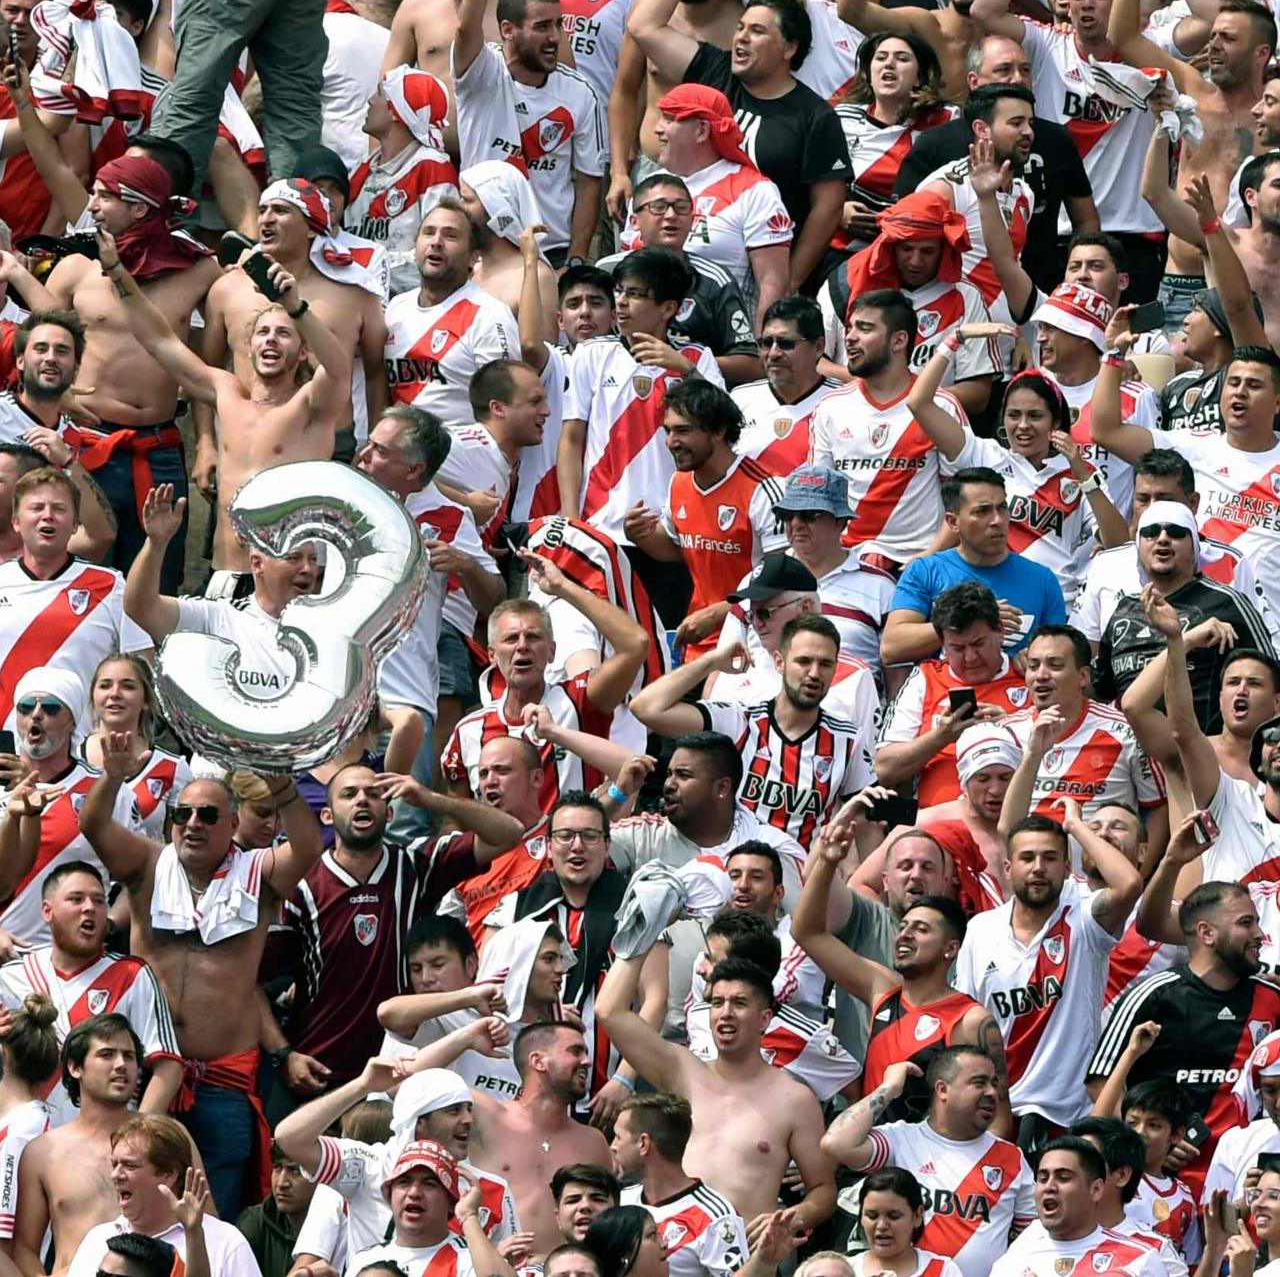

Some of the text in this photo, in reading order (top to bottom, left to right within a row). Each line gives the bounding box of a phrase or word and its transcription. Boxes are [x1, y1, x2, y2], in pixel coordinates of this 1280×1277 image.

[834, 455, 926, 471] PETROBRAS
[1008, 499, 1063, 536] BVA
[694, 536, 741, 552] Francés
[239, 670, 279, 689] BBVA
[741, 775, 822, 817] BBVA
[349, 893, 377, 903] adidas
[991, 975, 1062, 1019] BBVA
[1176, 1068, 1239, 1084] PETRO
[0, 1153, 17, 1210] NETSHOES
